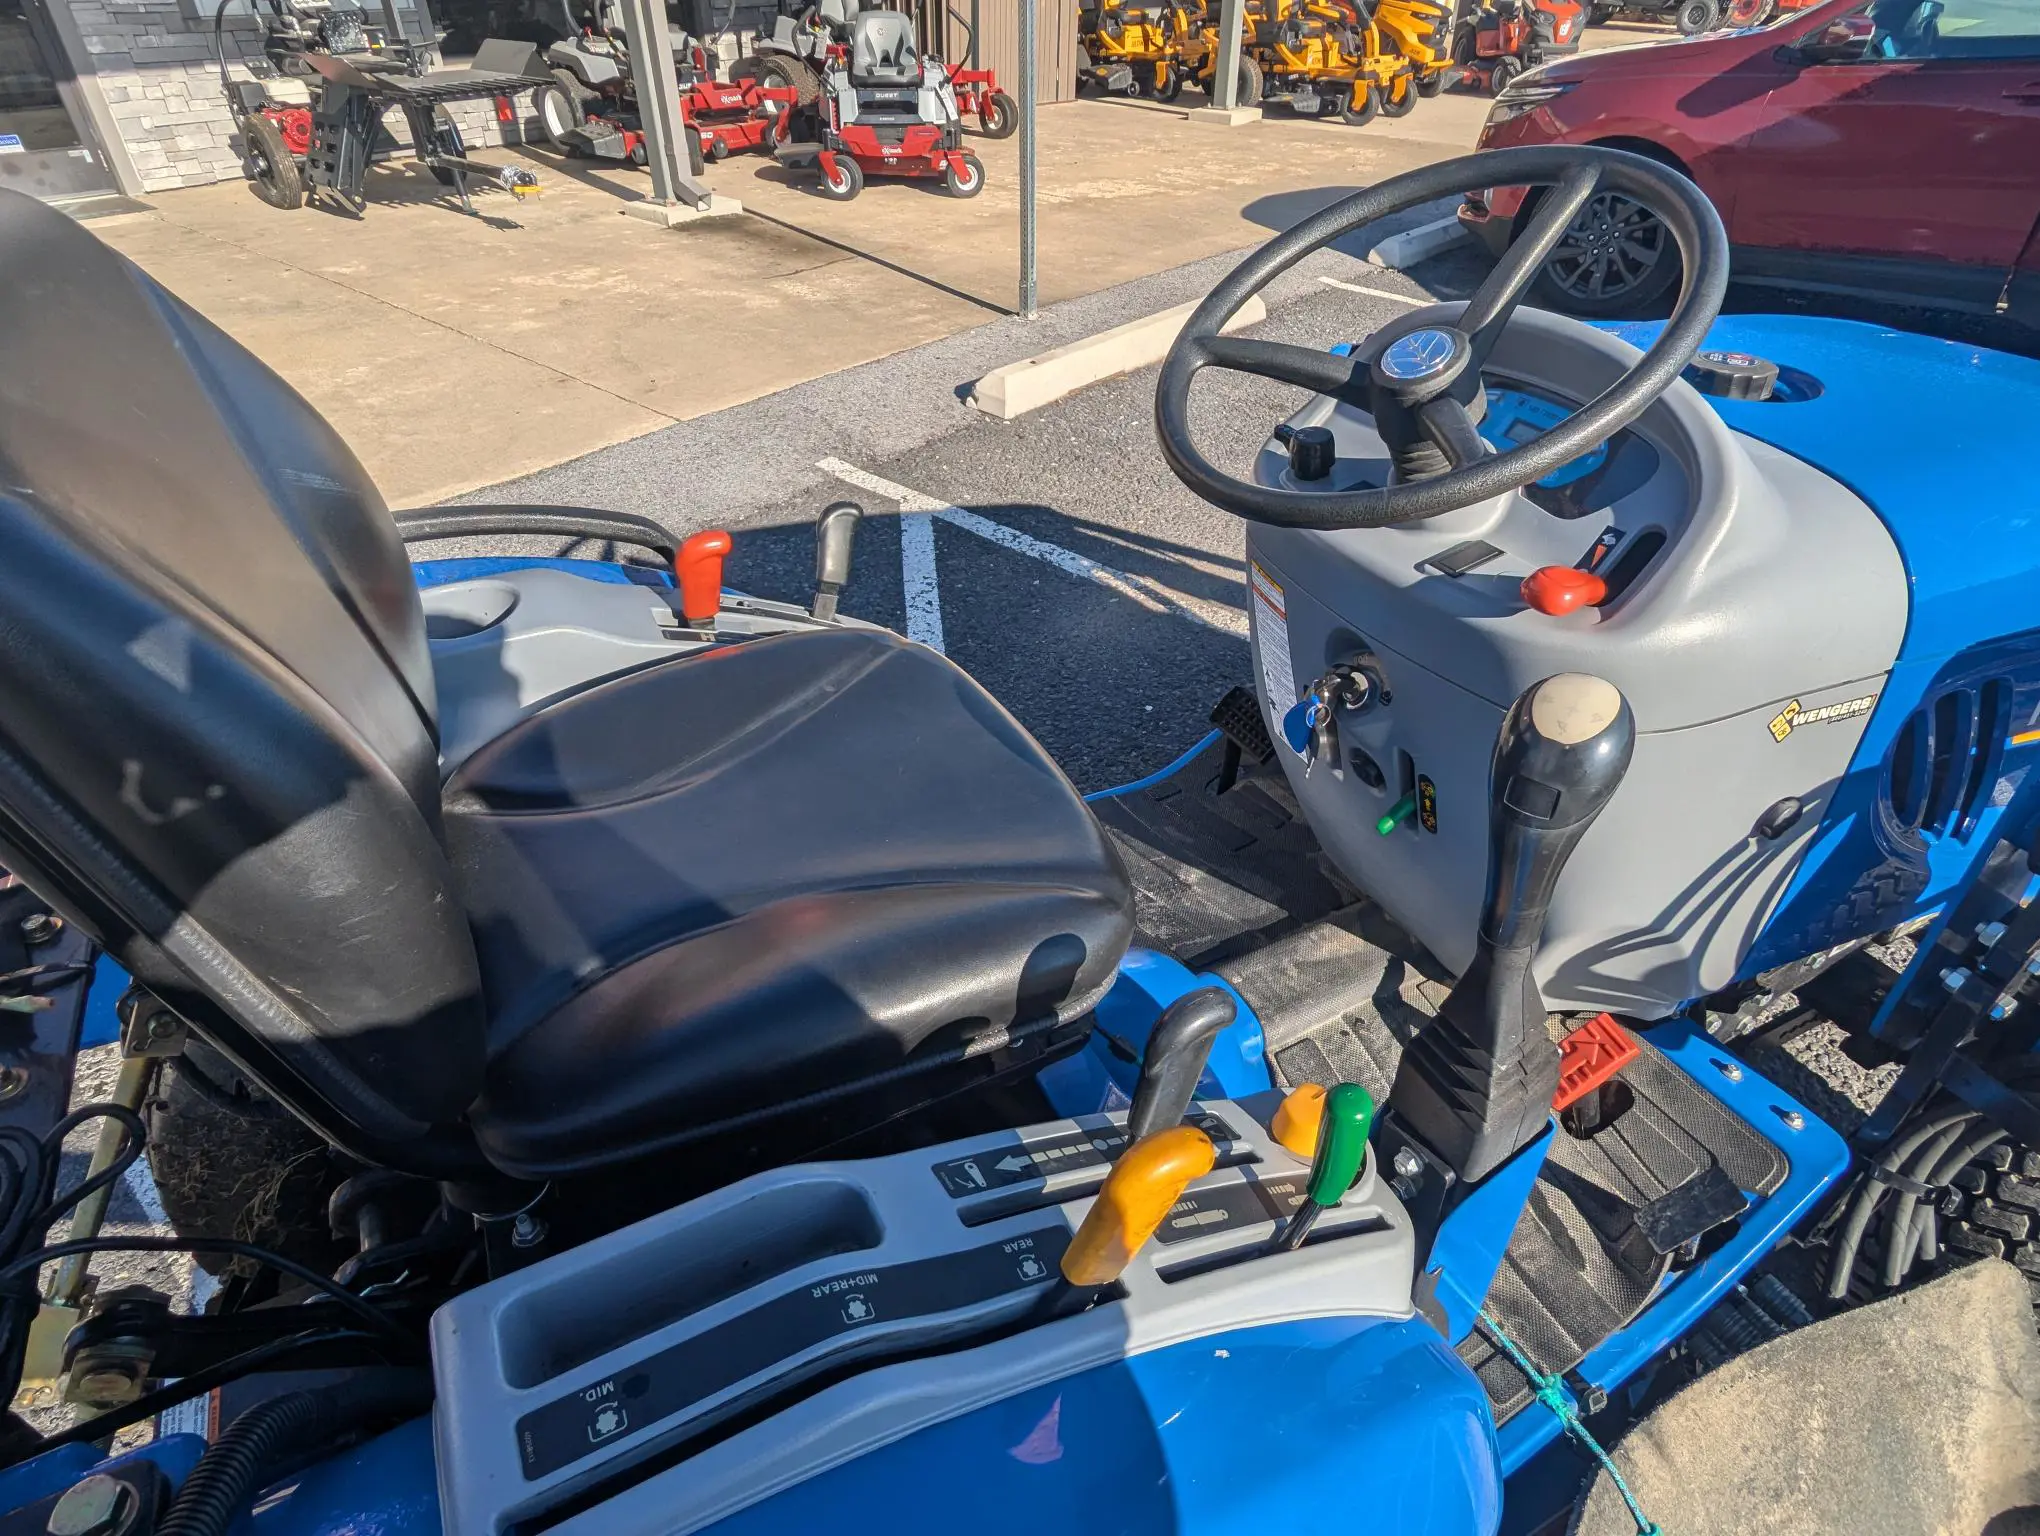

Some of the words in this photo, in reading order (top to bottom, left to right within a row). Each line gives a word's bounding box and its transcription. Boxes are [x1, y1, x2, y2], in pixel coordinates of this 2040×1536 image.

[1002, 1238, 1034, 1254] REAR
[811, 1273, 879, 1299] MID+REAR
[579, 1380, 615, 1402] MID.
